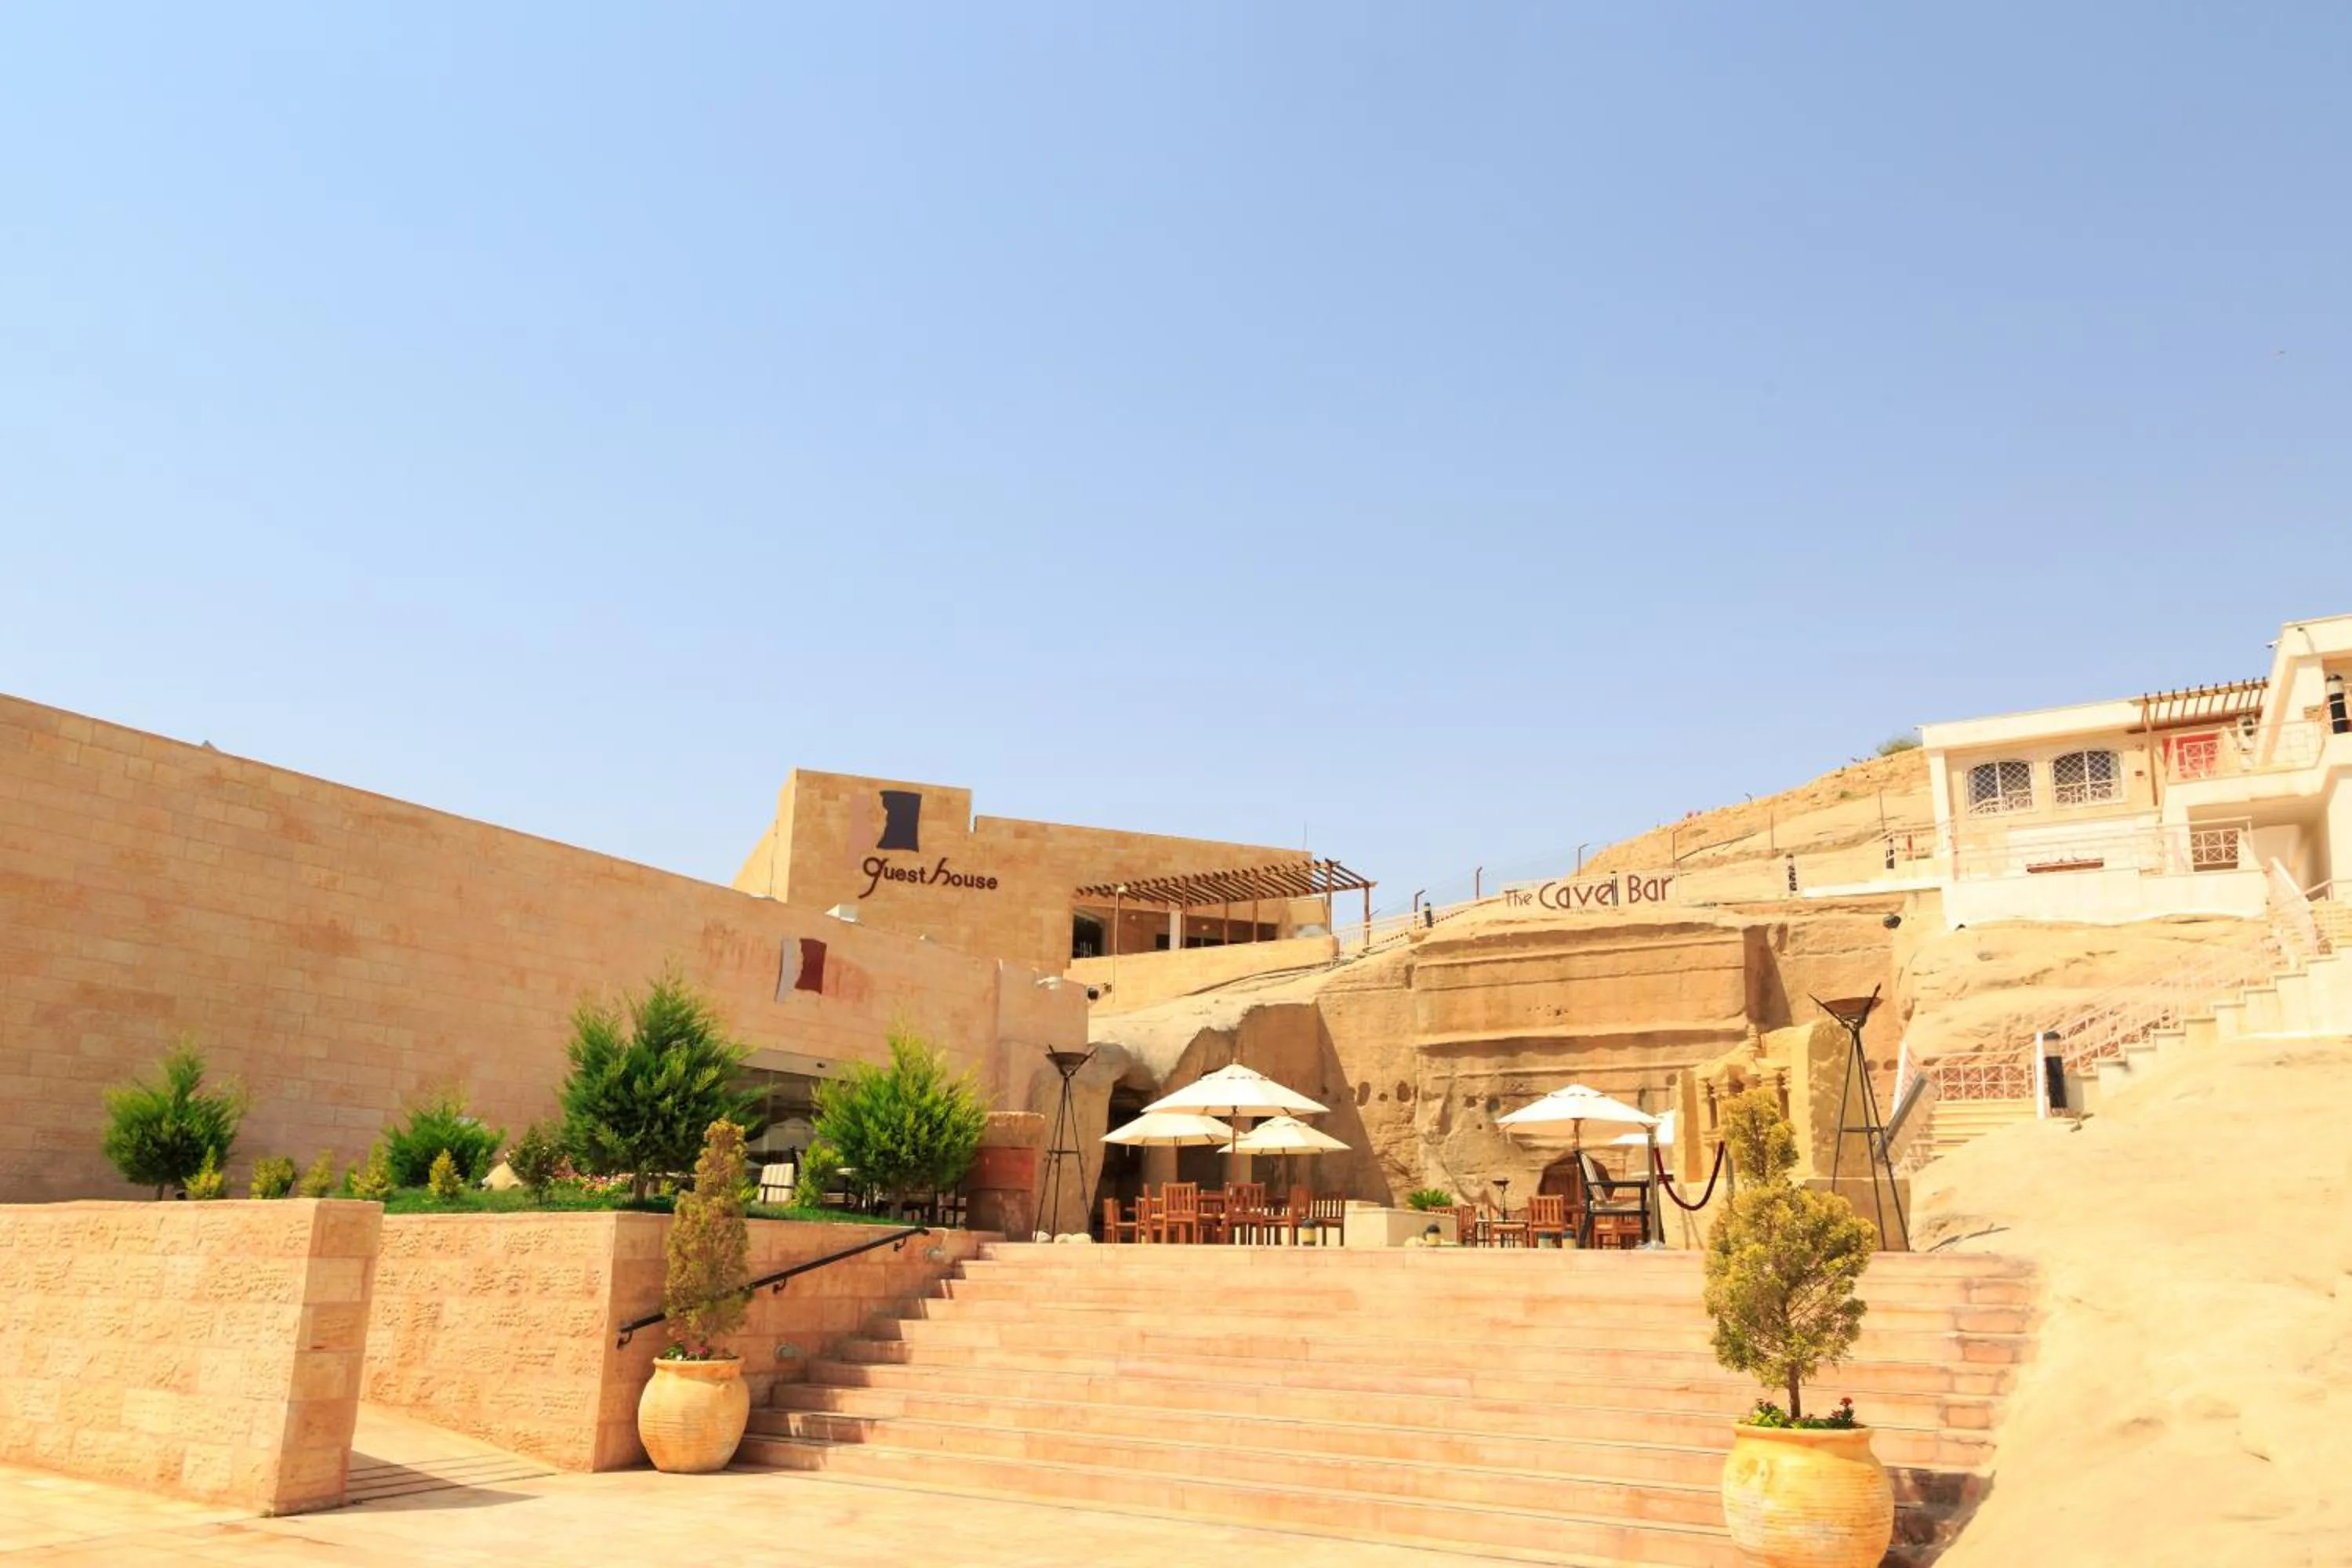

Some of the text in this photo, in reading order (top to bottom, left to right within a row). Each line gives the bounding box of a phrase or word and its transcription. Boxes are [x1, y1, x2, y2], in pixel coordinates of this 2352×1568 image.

[858, 856, 999, 899] guest house
[1504, 874, 1674, 909] The Cave Bar
